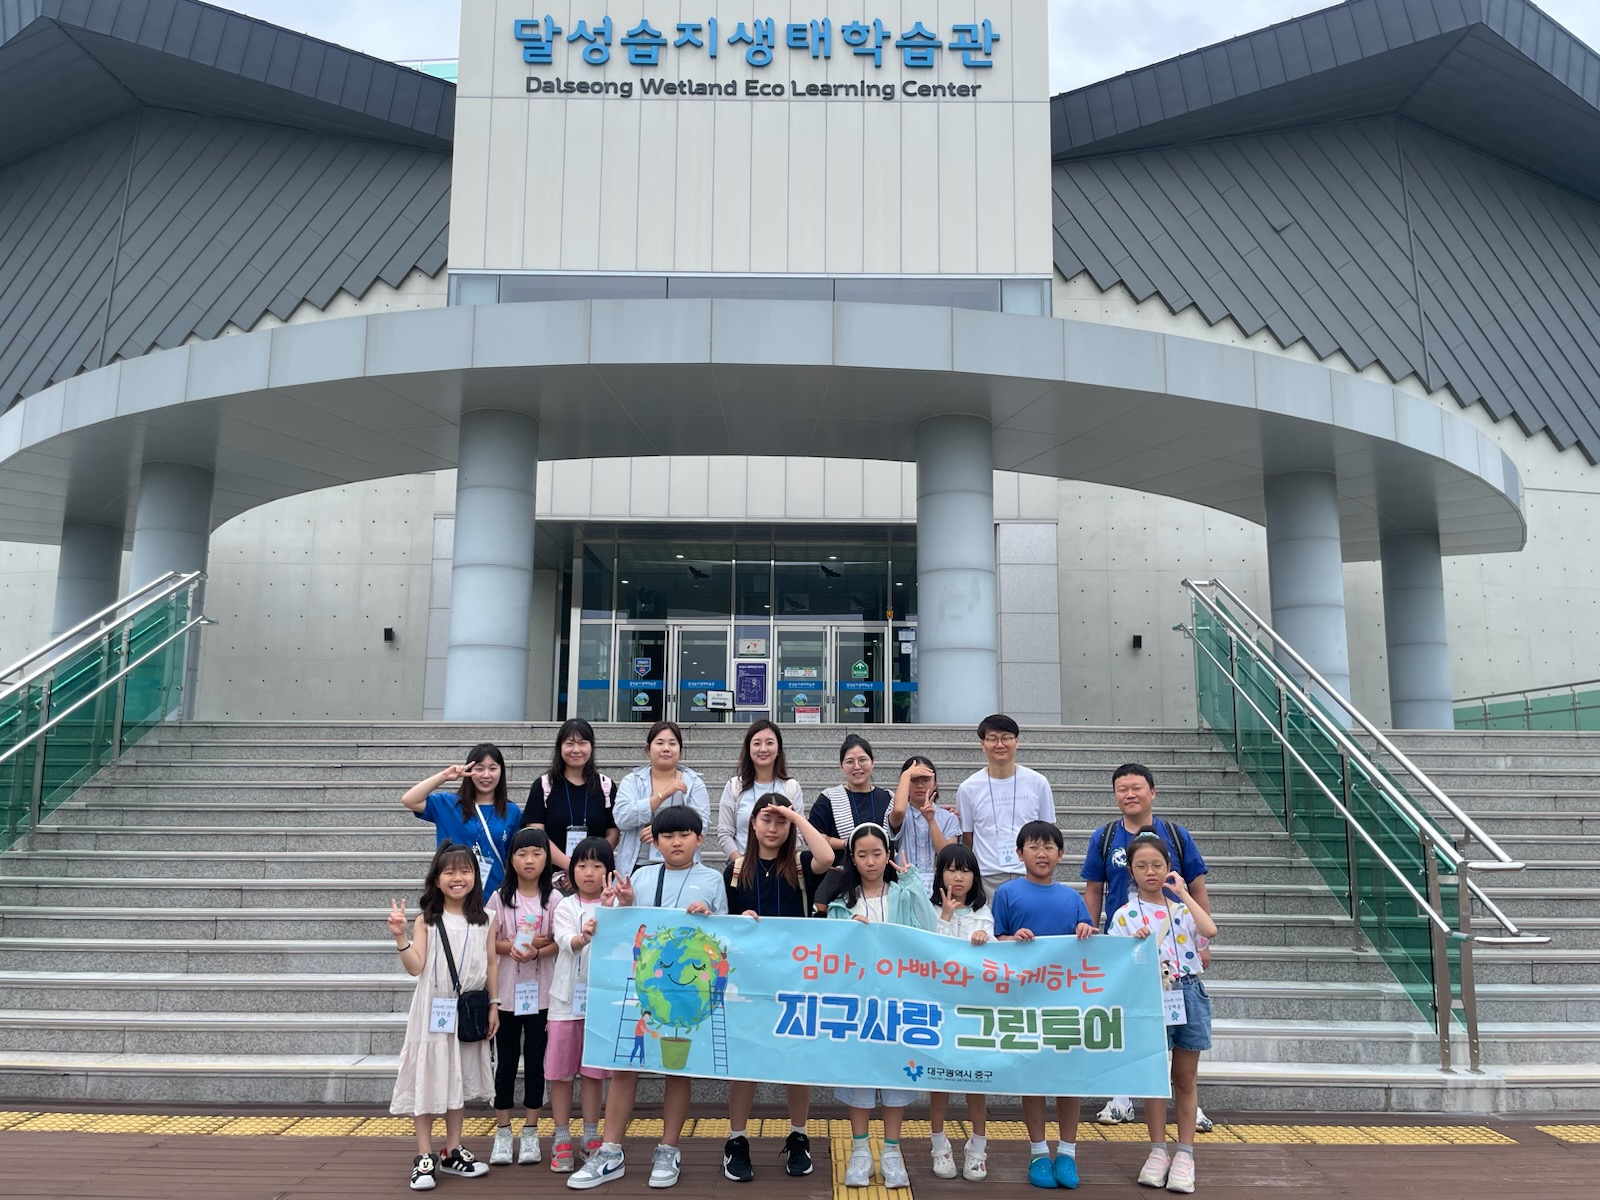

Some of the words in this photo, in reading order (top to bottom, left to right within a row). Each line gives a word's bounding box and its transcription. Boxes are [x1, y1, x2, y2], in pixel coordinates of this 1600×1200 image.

[513, 15, 1001, 68] 달성습지생태학습관
[526, 76, 633, 96] Dalseong
[640, 77, 737, 96] Wetland
[745, 79, 785, 96] Eco
[791, 79, 895, 100] Learning
[902, 80, 982, 97] Center
[792, 943, 865, 980] 엄마,
[876, 959, 974, 987] 아빠와
[983, 958, 1106, 994] 함께하는
[774, 993, 943, 1047] 지구사랑
[956, 1007, 1123, 1051] 그린투어
[927, 1067, 972, 1079] 대구광역시
[974, 1070, 993, 1080] 중구
